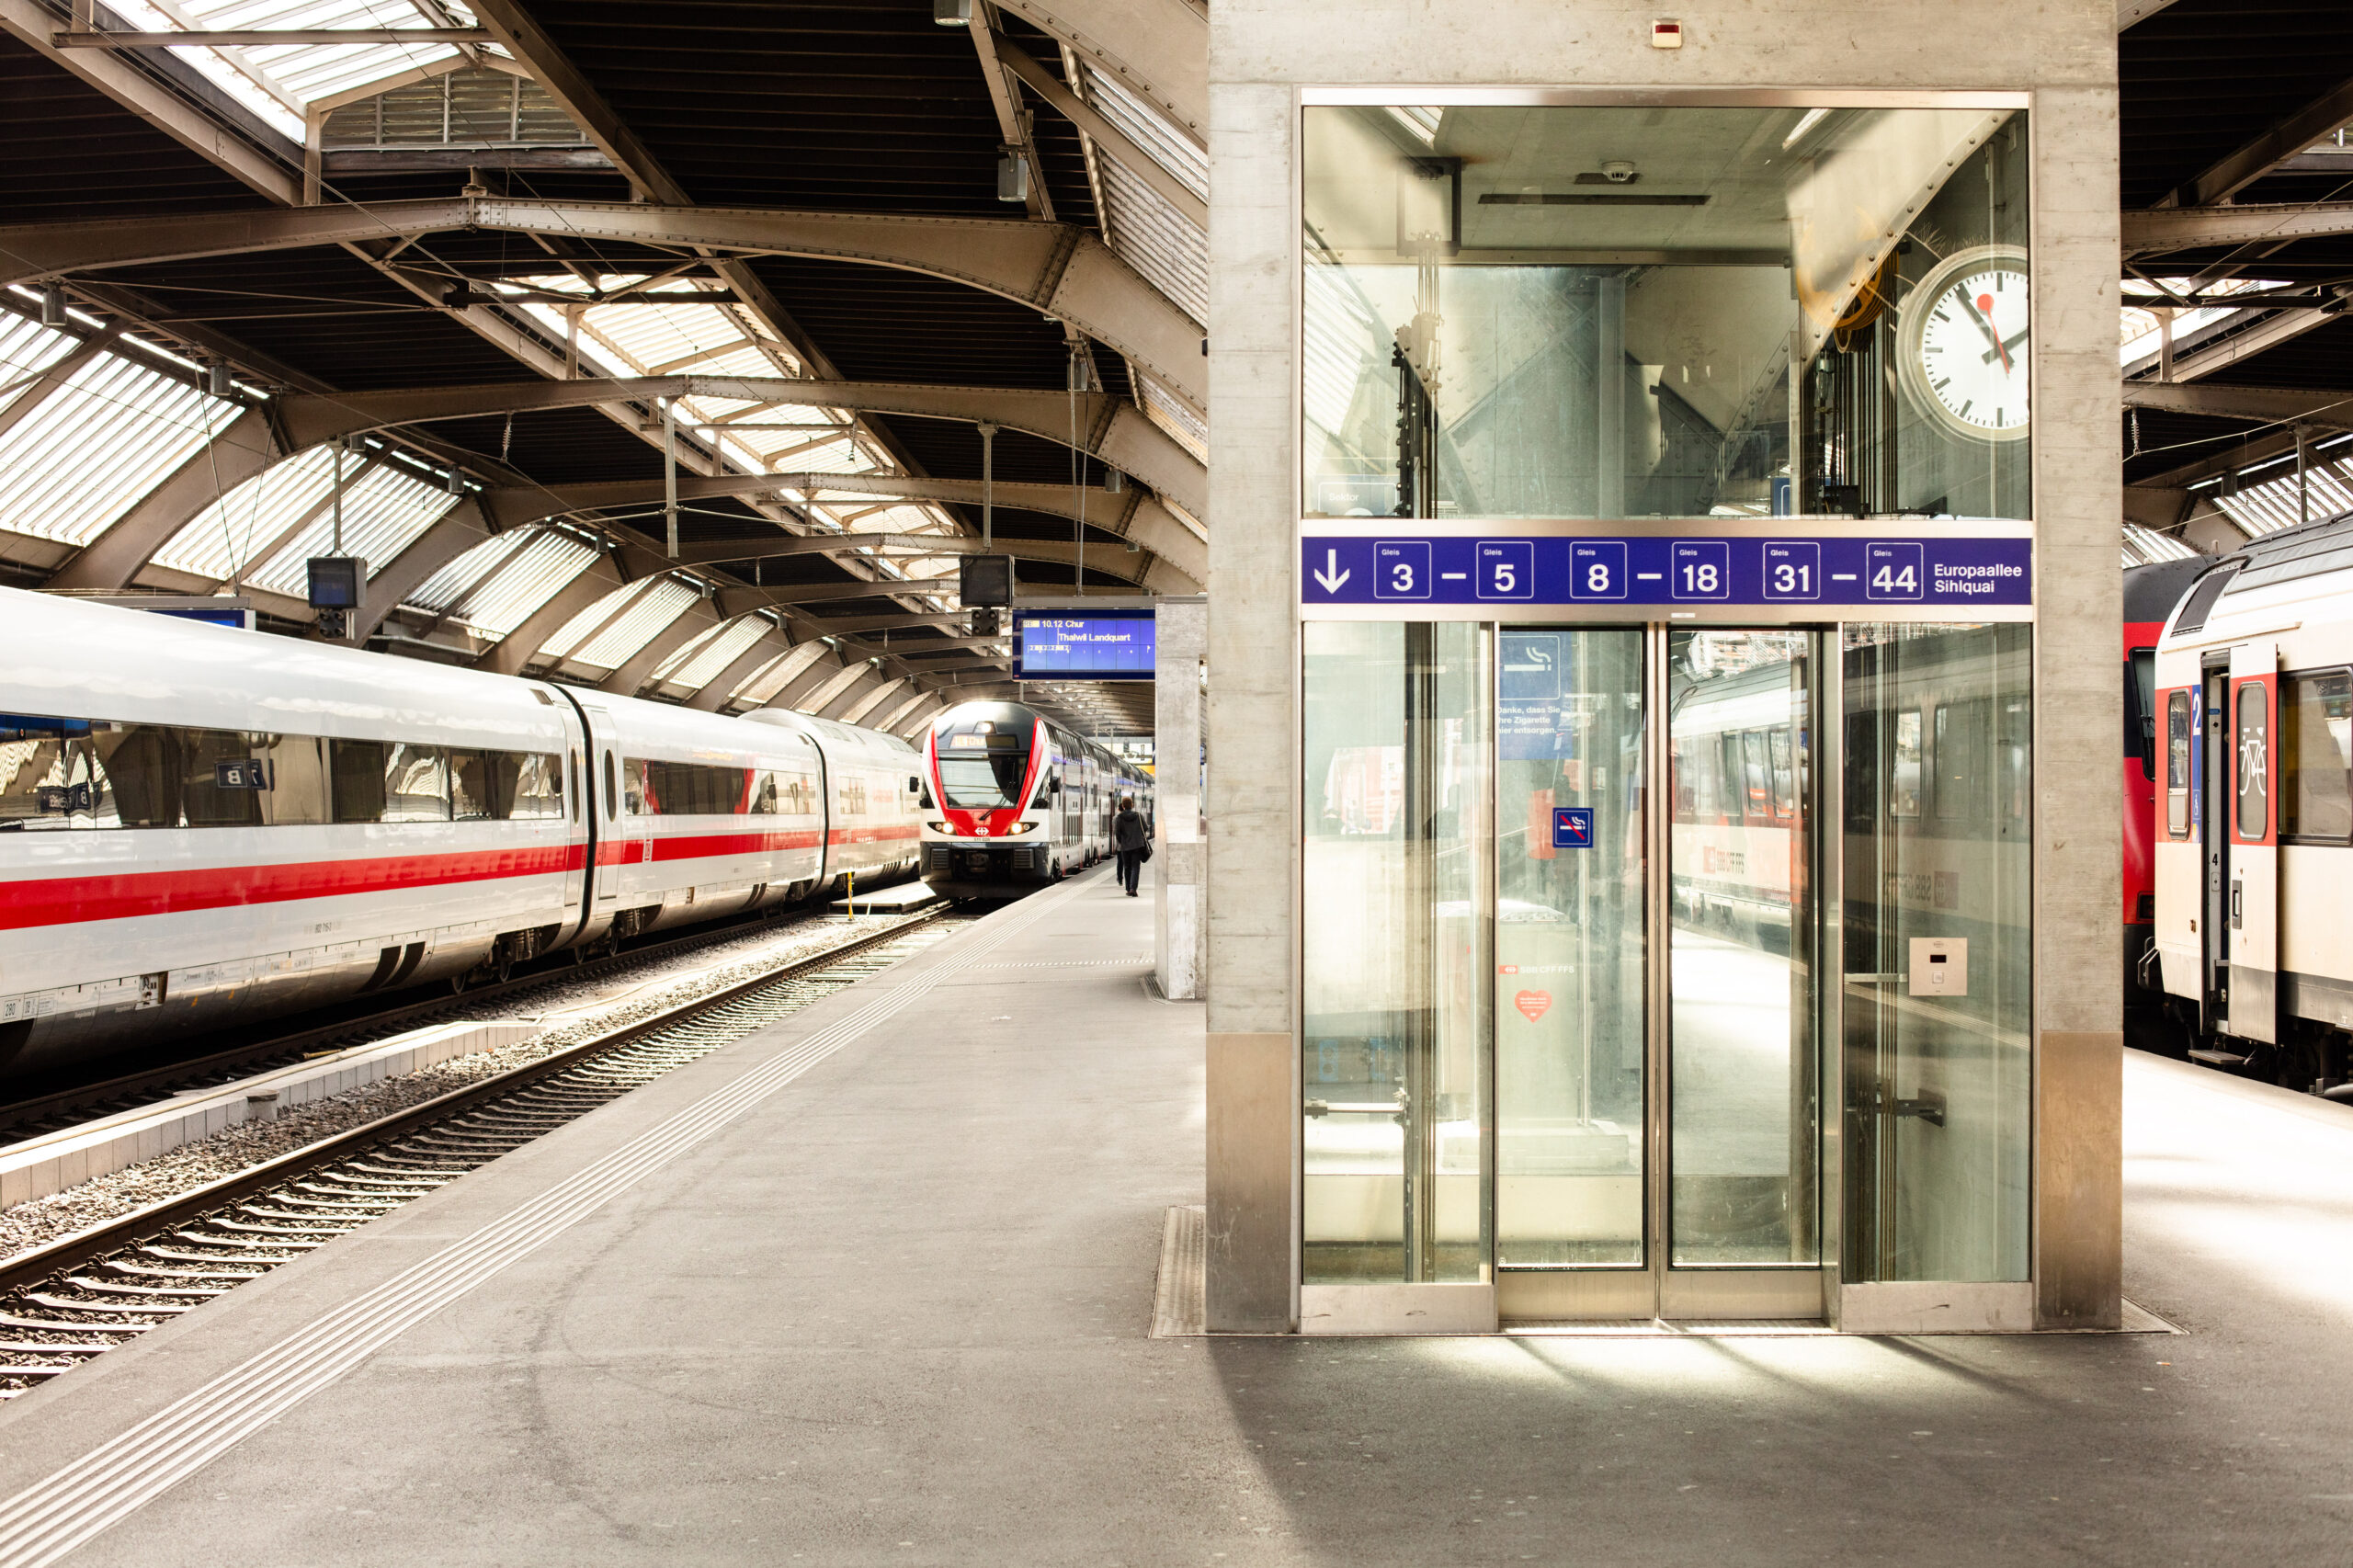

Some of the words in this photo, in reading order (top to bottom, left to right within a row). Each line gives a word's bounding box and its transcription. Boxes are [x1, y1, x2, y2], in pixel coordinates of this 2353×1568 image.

[1329, 493, 1359, 501] Sektor
[1770, 549, 1790, 557] Gleis
[1392, 563, 1414, 592] 3
[1495, 563, 1516, 592] 5
[1587, 563, 1609, 592] 8
[1682, 563, 1719, 593] 18
[1774, 563, 1810, 593] 31
[1872, 564, 1918, 593] 44
[1934, 563, 2023, 580] Europaallee
[1934, 579, 1995, 596] Sihlquai
[1059, 633, 1087, 642] Thalwil
[1089, 633, 1131, 643] Landquart
[1514, 716, 1551, 725] Zigarette
[2193, 692, 2200, 735] 2
[1514, 726, 1557, 735] entsorgen.
[2211, 854, 2219, 866] 4
